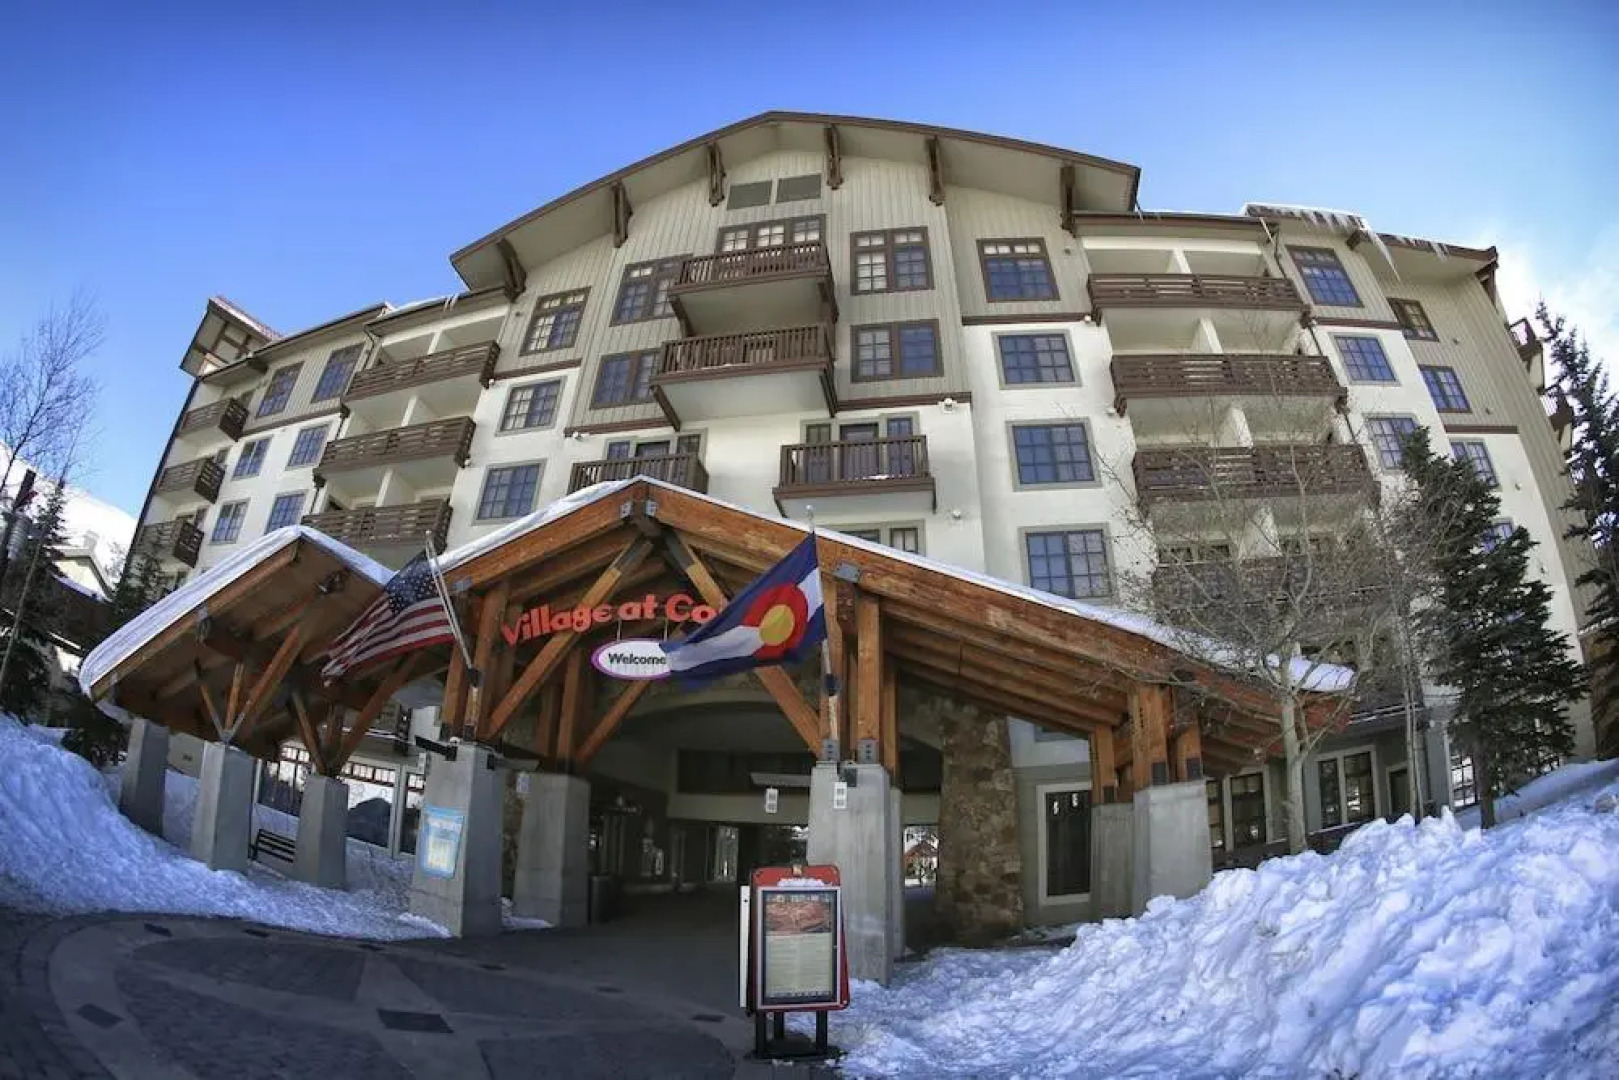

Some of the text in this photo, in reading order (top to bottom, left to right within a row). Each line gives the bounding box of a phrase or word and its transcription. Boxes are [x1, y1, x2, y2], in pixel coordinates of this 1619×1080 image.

[501, 594, 717, 646] Village at Co
[608, 653, 667, 665] Welcome
